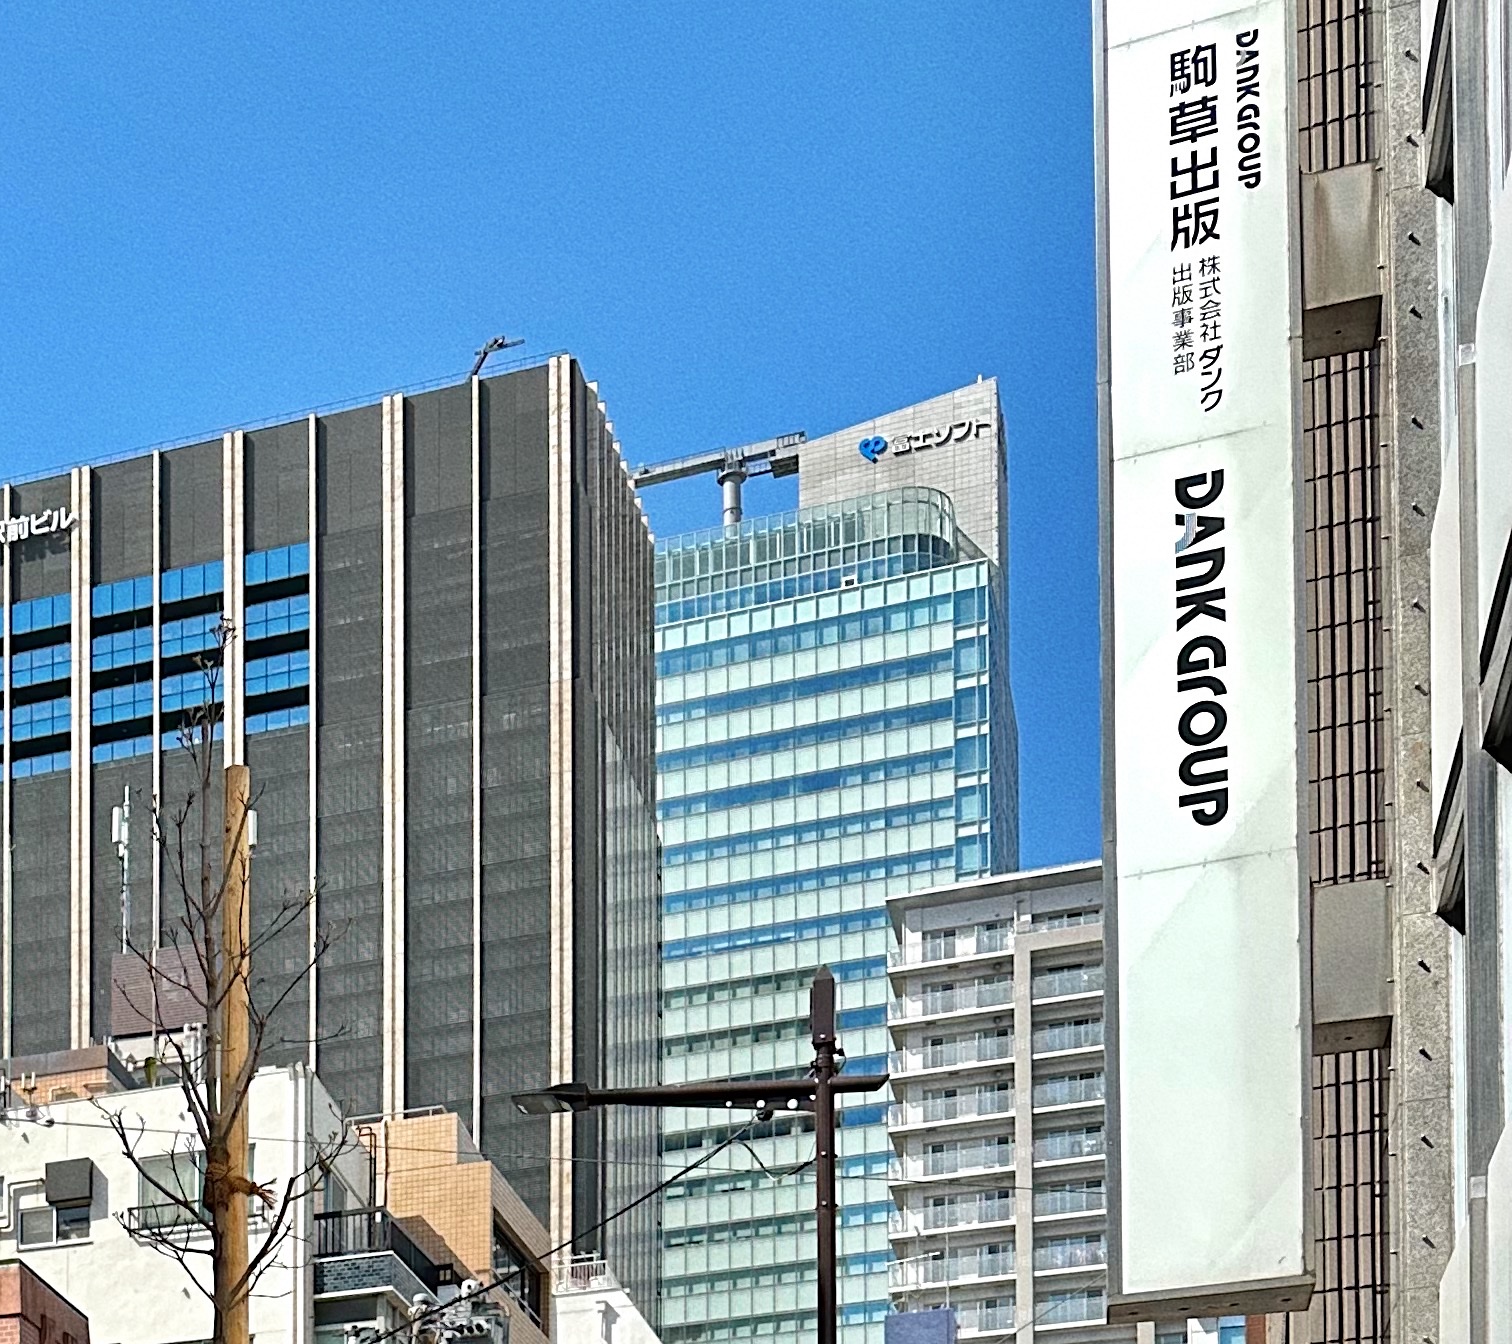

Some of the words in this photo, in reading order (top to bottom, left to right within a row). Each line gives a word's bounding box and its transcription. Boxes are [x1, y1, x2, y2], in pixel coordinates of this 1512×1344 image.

[1168, 42, 1221, 253] 駒草出版
[1171, 262, 1195, 376] 出版事業部
[891, 417, 992, 457] 富士ソフト
